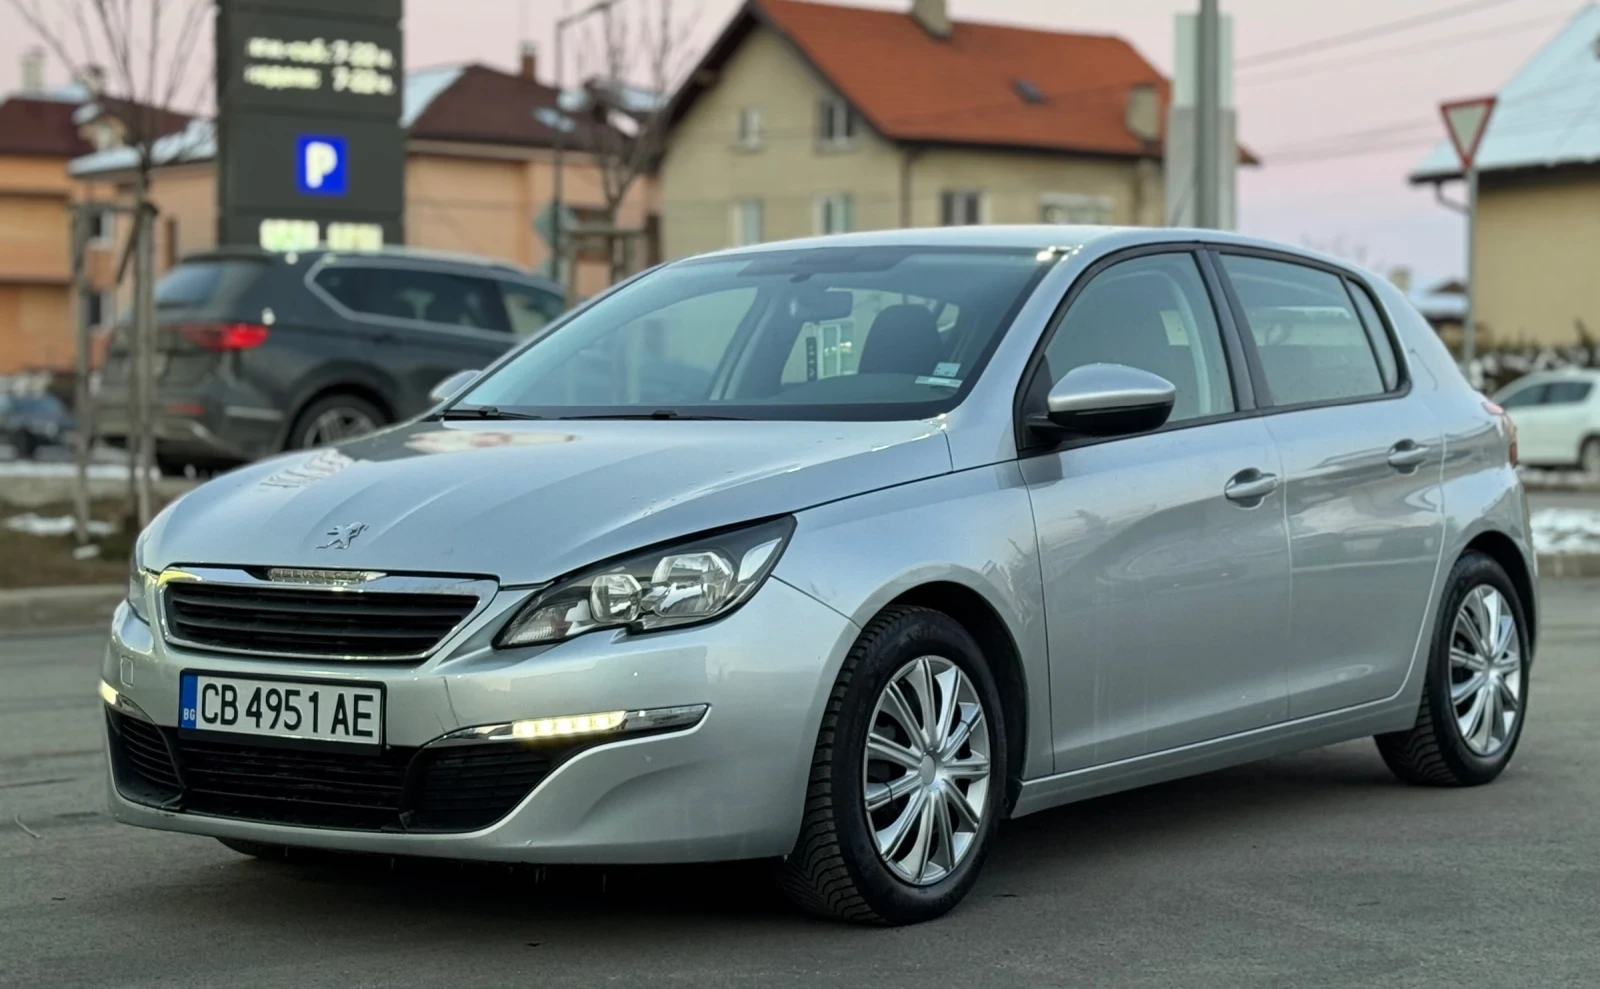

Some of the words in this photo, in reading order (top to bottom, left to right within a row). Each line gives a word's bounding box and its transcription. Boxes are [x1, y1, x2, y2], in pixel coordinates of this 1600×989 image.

[305, 141, 338, 189] P
[183, 708, 196, 721] BG
[202, 683, 238, 726] CB
[245, 686, 320, 734] 4951
[330, 693, 374, 738] AE
